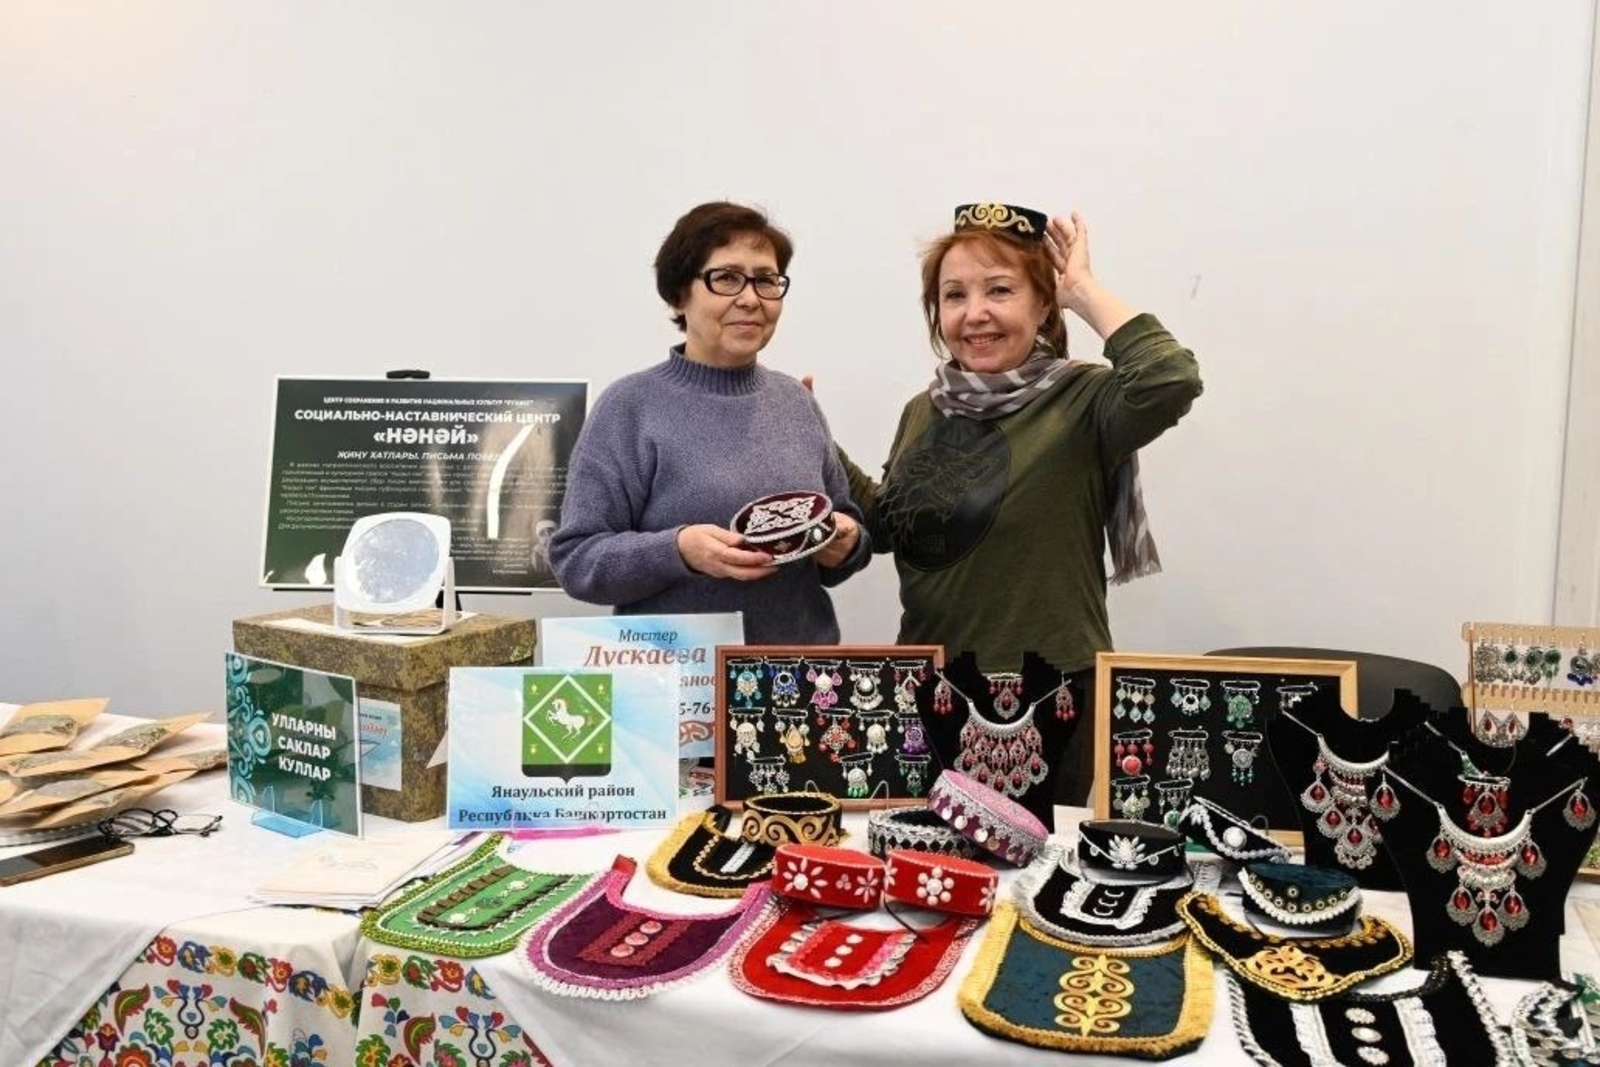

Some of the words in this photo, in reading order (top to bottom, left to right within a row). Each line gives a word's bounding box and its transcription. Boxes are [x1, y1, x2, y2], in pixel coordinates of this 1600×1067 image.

[294, 409, 513, 423] СОЦИАЛЬНО-НАСТАВНИЧЕСКИЙ
[516, 413, 561, 424] ЦЕНТР
[373, 424, 479, 445] «НӘНӘЙ»
[421, 452, 465, 461] ПИСЬМА
[618, 629, 678, 644] Мастер
[271, 712, 336, 740] УЛЛАРНЫ
[278, 736, 331, 759] САКЛАР
[279, 756, 331, 781] КУЛЛАР
[491, 785, 584, 800] Янаульский
[588, 785, 635, 799] район
